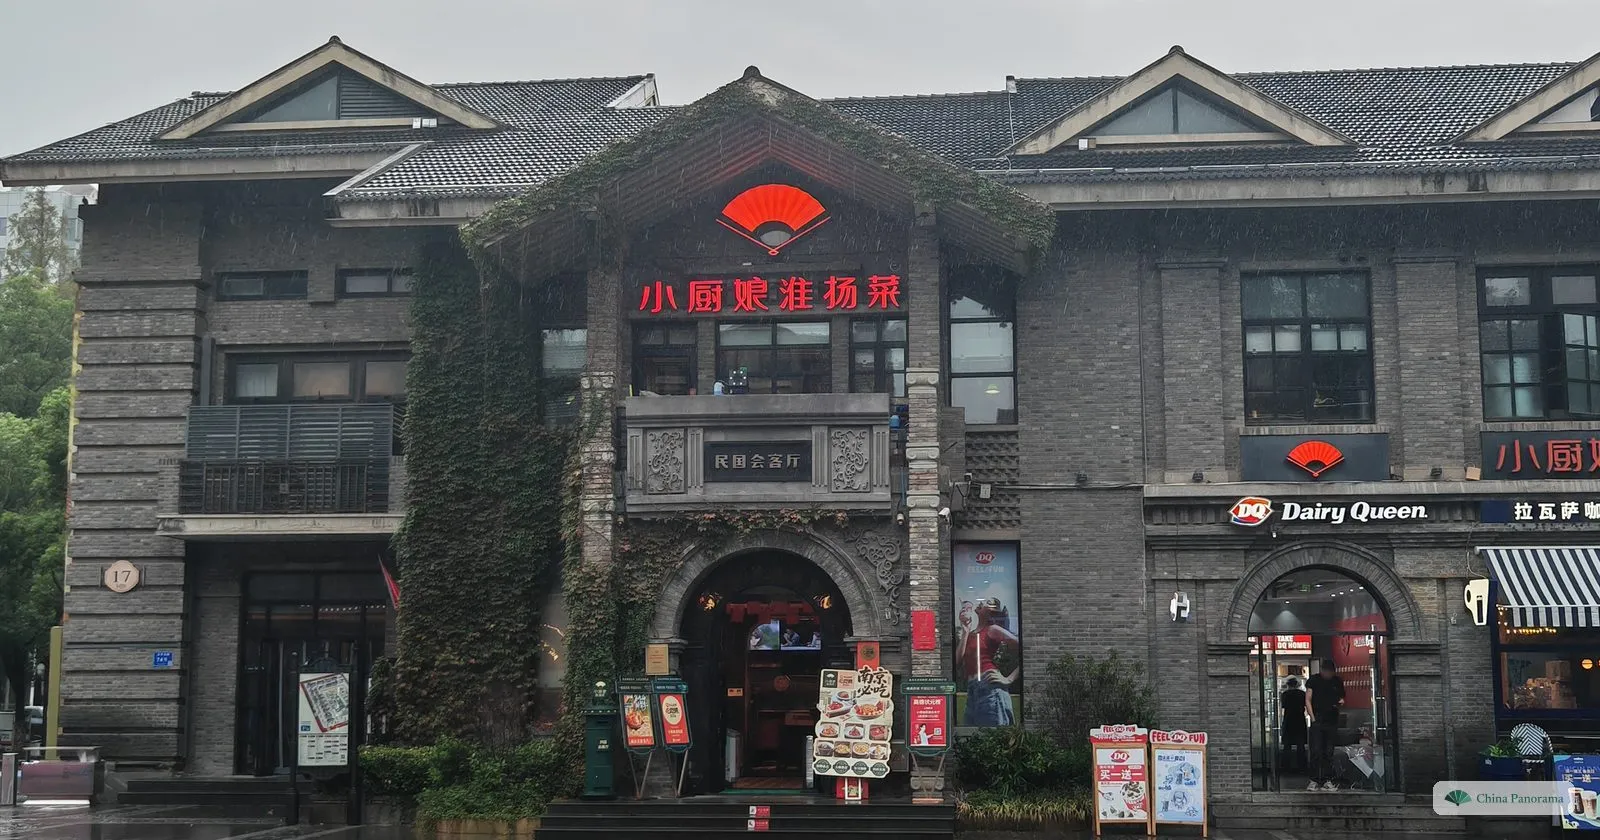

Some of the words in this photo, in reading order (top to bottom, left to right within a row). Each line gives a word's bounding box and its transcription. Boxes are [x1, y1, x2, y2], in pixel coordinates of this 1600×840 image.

[639, 275, 901, 313] 小厨娘淮扬菜
[714, 453, 801, 470] 民国会客厅
[1237, 503, 1267, 519] DQ
[1281, 502, 1346, 524] Dairy
[113, 570, 132, 583] 17
[857, 666, 889, 684] 南京
[857, 685, 890, 699] 必吃
[1151, 731, 1171, 742] FEEL
[1189, 732, 1206, 744] FUN
[1113, 752, 1128, 760] DQ
[1100, 769, 1143, 780] 买一送一
